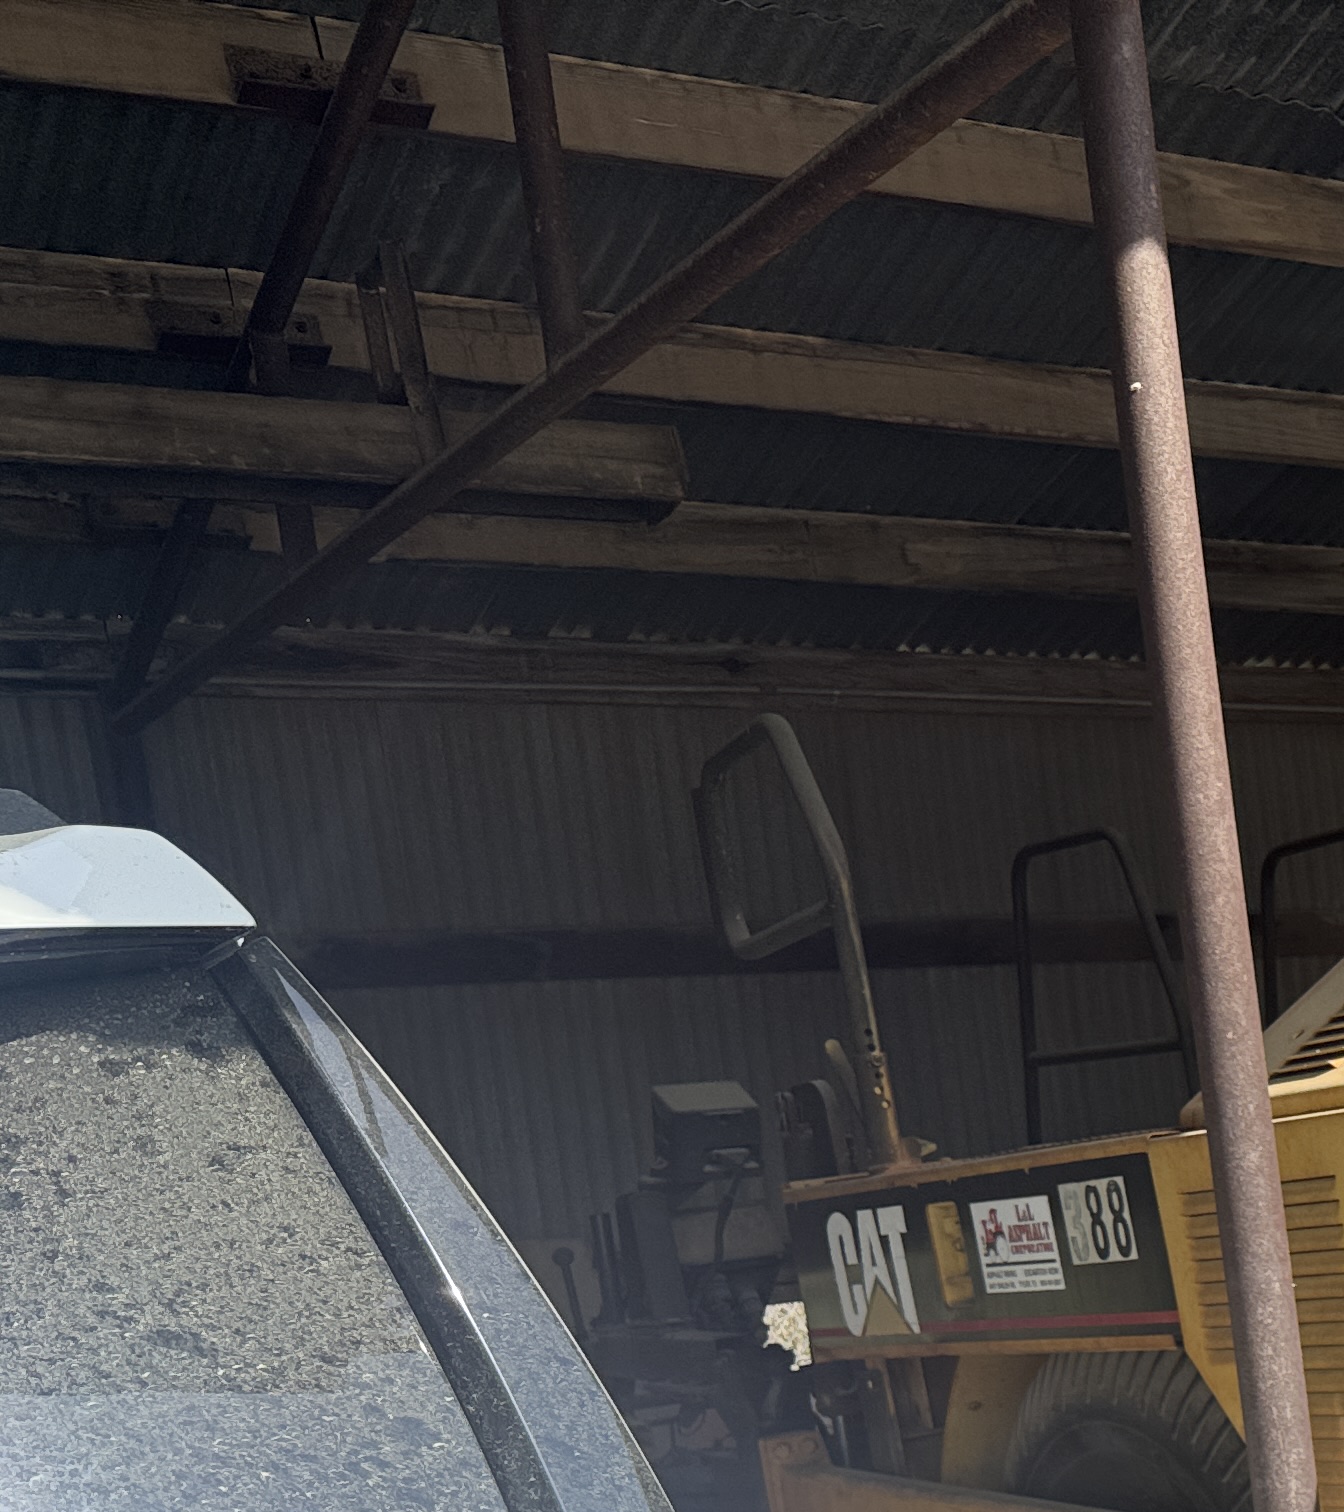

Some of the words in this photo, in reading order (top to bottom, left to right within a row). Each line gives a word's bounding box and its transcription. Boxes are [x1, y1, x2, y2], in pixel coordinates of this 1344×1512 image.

[1007, 1221, 1050, 1243] ASPHALT
[1063, 1180, 1132, 1261] 388
[827, 1205, 921, 1337] CAT
